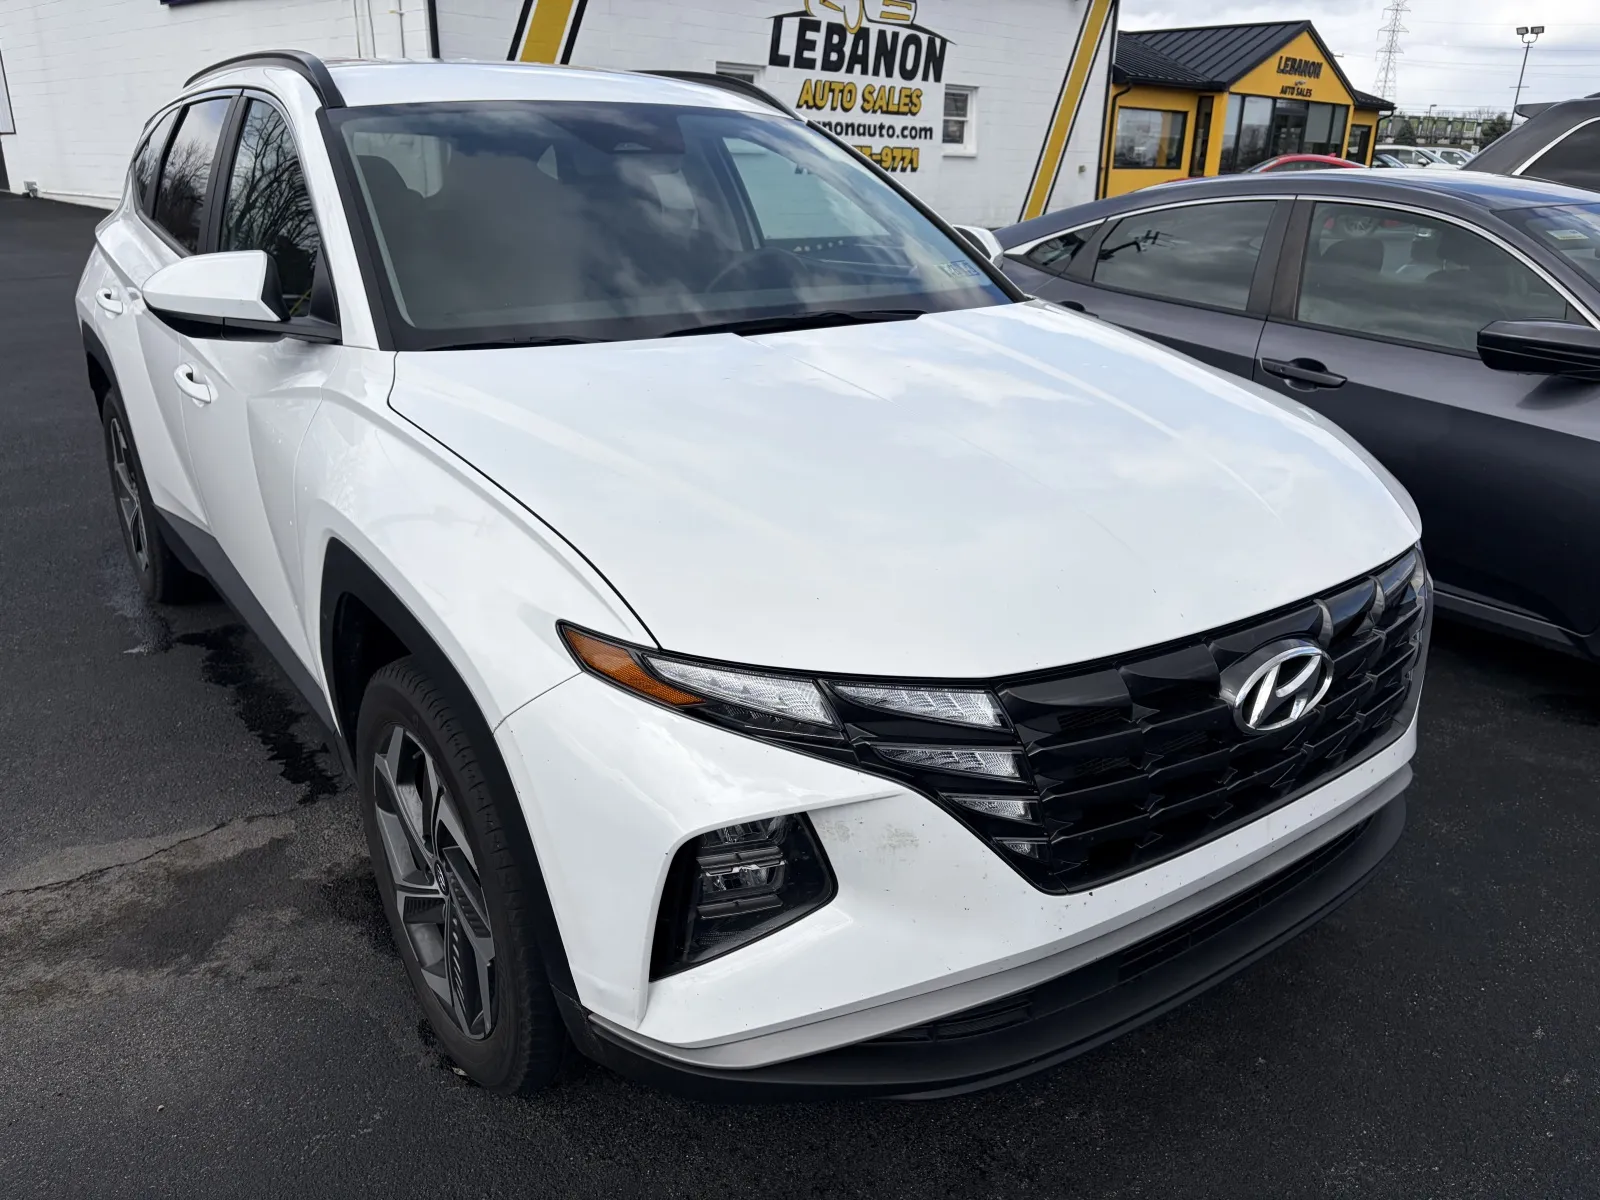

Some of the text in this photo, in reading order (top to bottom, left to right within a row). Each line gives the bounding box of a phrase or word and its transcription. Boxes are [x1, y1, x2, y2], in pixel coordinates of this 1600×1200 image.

[769, 17, 947, 83] LEBANON
[1276, 56, 1323, 79] LEBANON
[796, 79, 923, 116] AUTO SALES
[1280, 85, 1313, 98] AUTO SALES
[814, 119, 933, 140] nonauto.com
[852, 144, 920, 172] -9771
